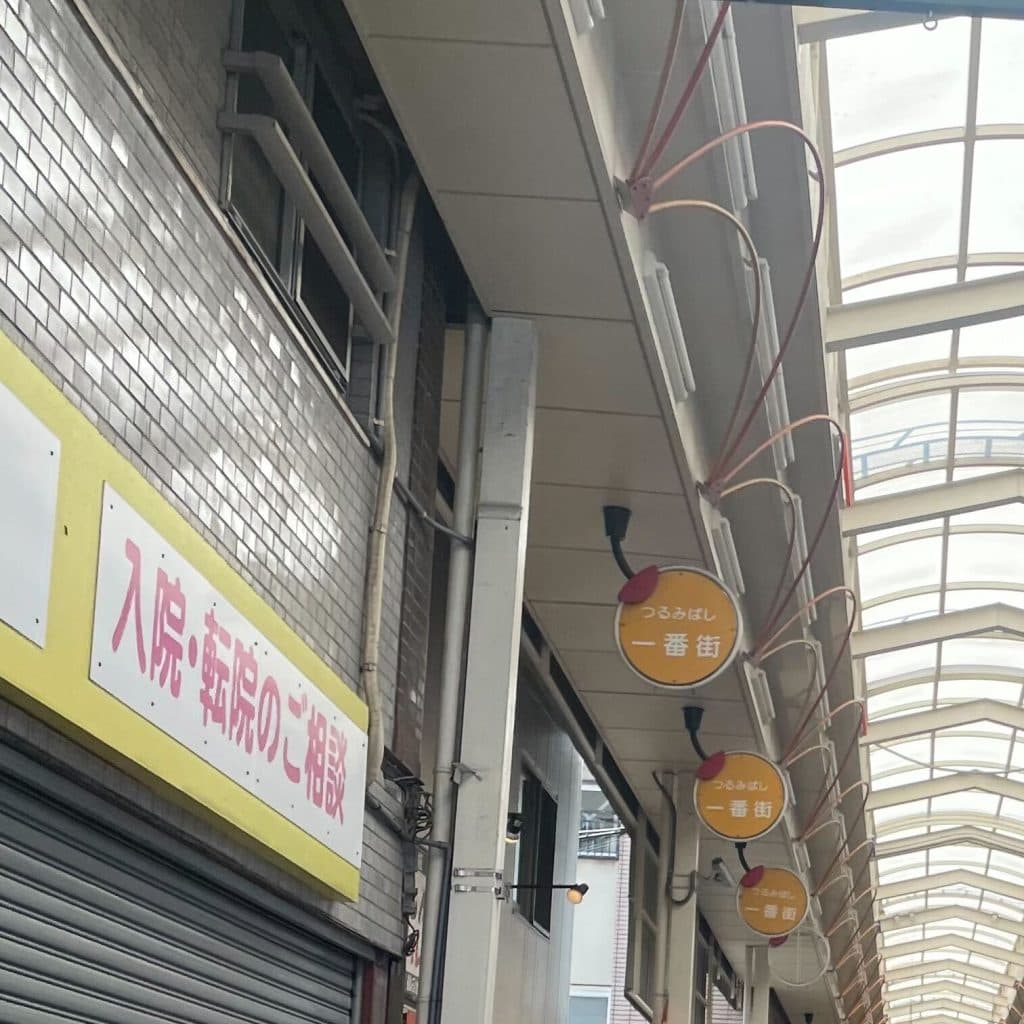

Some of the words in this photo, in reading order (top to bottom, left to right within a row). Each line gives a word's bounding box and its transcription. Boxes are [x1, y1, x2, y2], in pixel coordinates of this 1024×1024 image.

[642, 606, 717, 621] つるみばし
[631, 633, 721, 658] 一番街
[705, 800, 773, 819] 一番街
